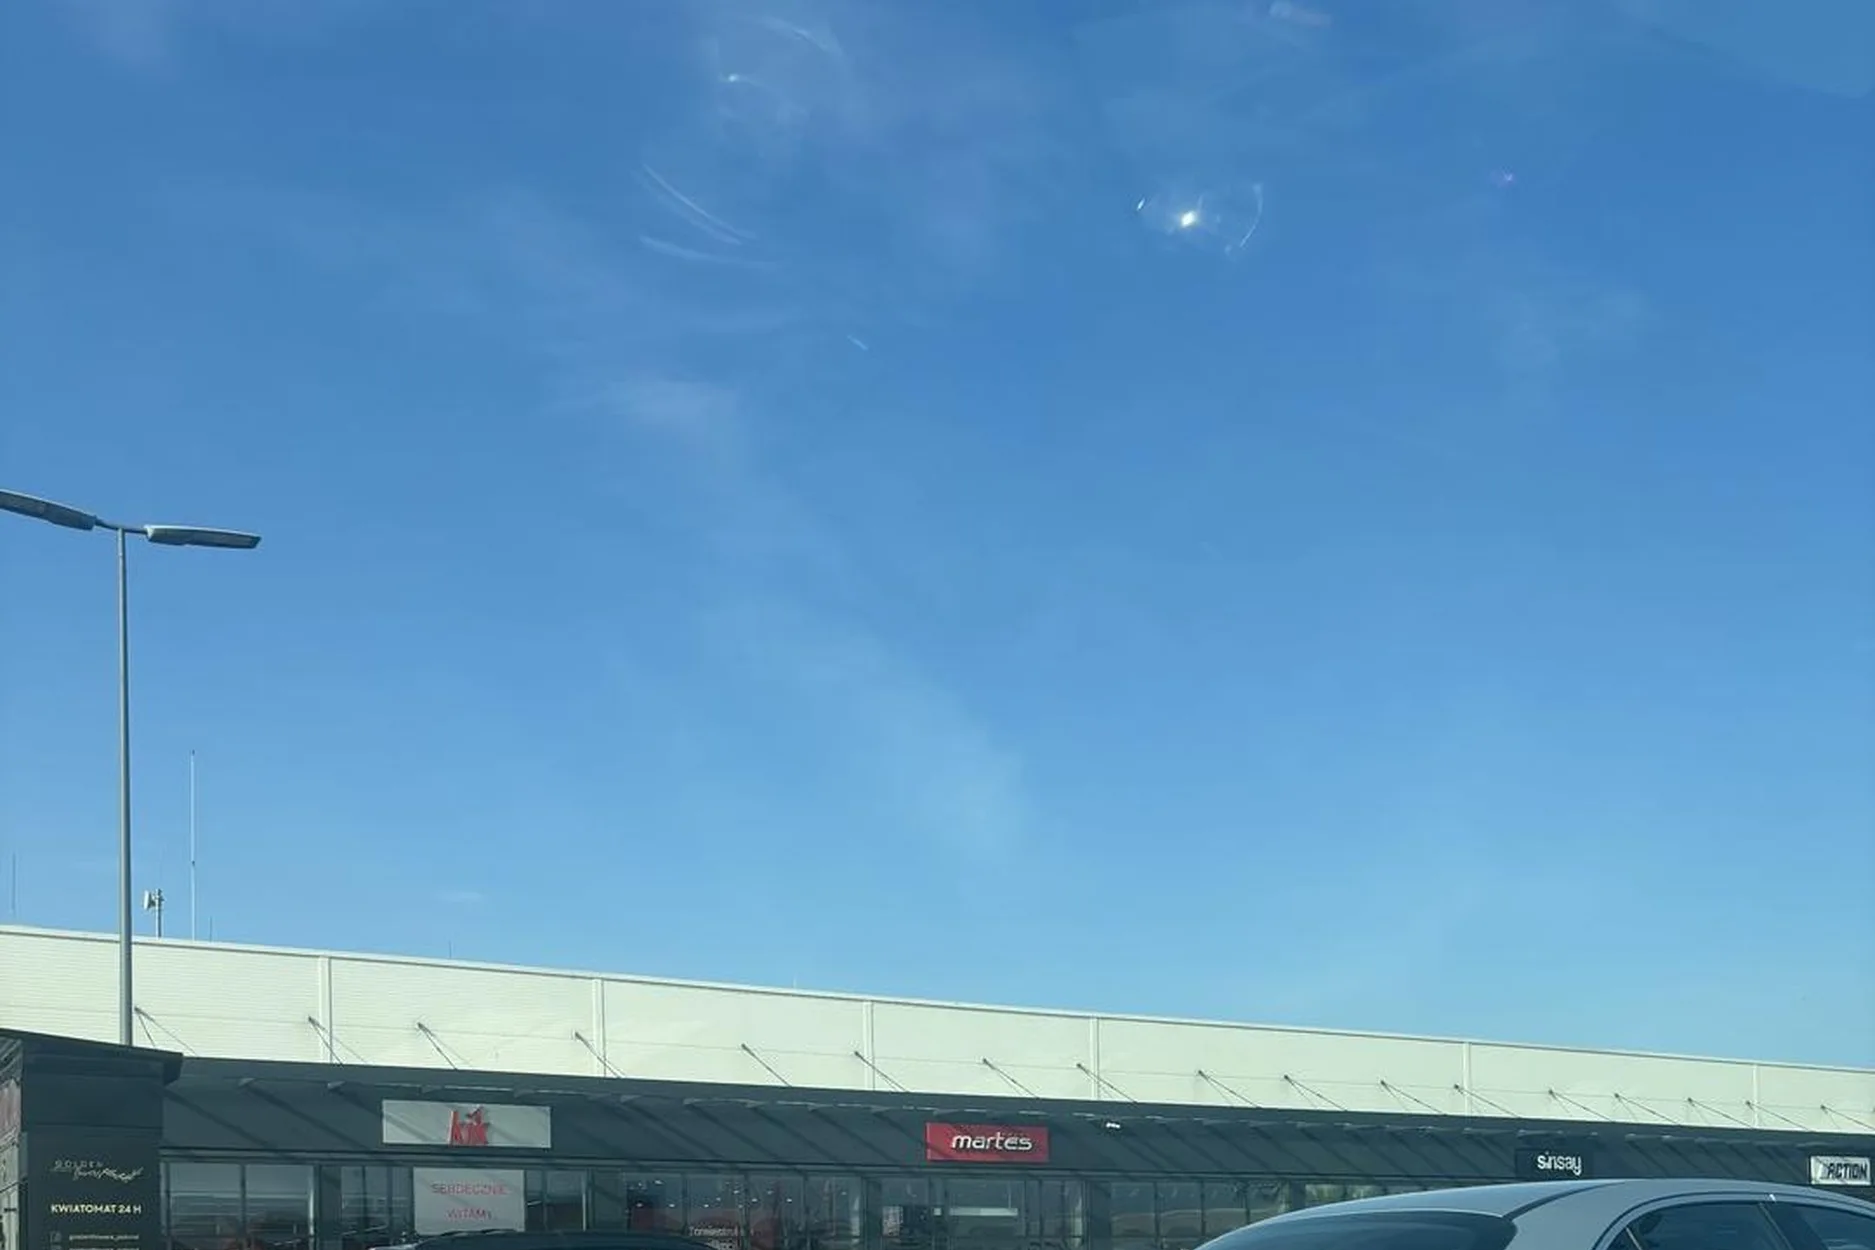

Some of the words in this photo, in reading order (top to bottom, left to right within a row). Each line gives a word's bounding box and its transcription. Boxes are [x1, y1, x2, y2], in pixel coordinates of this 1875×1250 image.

[952, 1131, 1033, 1151] martes
[1537, 1151, 1582, 1176] sinsay
[1828, 1162, 1868, 1179] ACTION
[431, 1183, 510, 1196] SERDECZNIE
[50, 1203, 116, 1214] KWIATOMAT
[118, 1204, 131, 1214] 24
[133, 1204, 142, 1214] H
